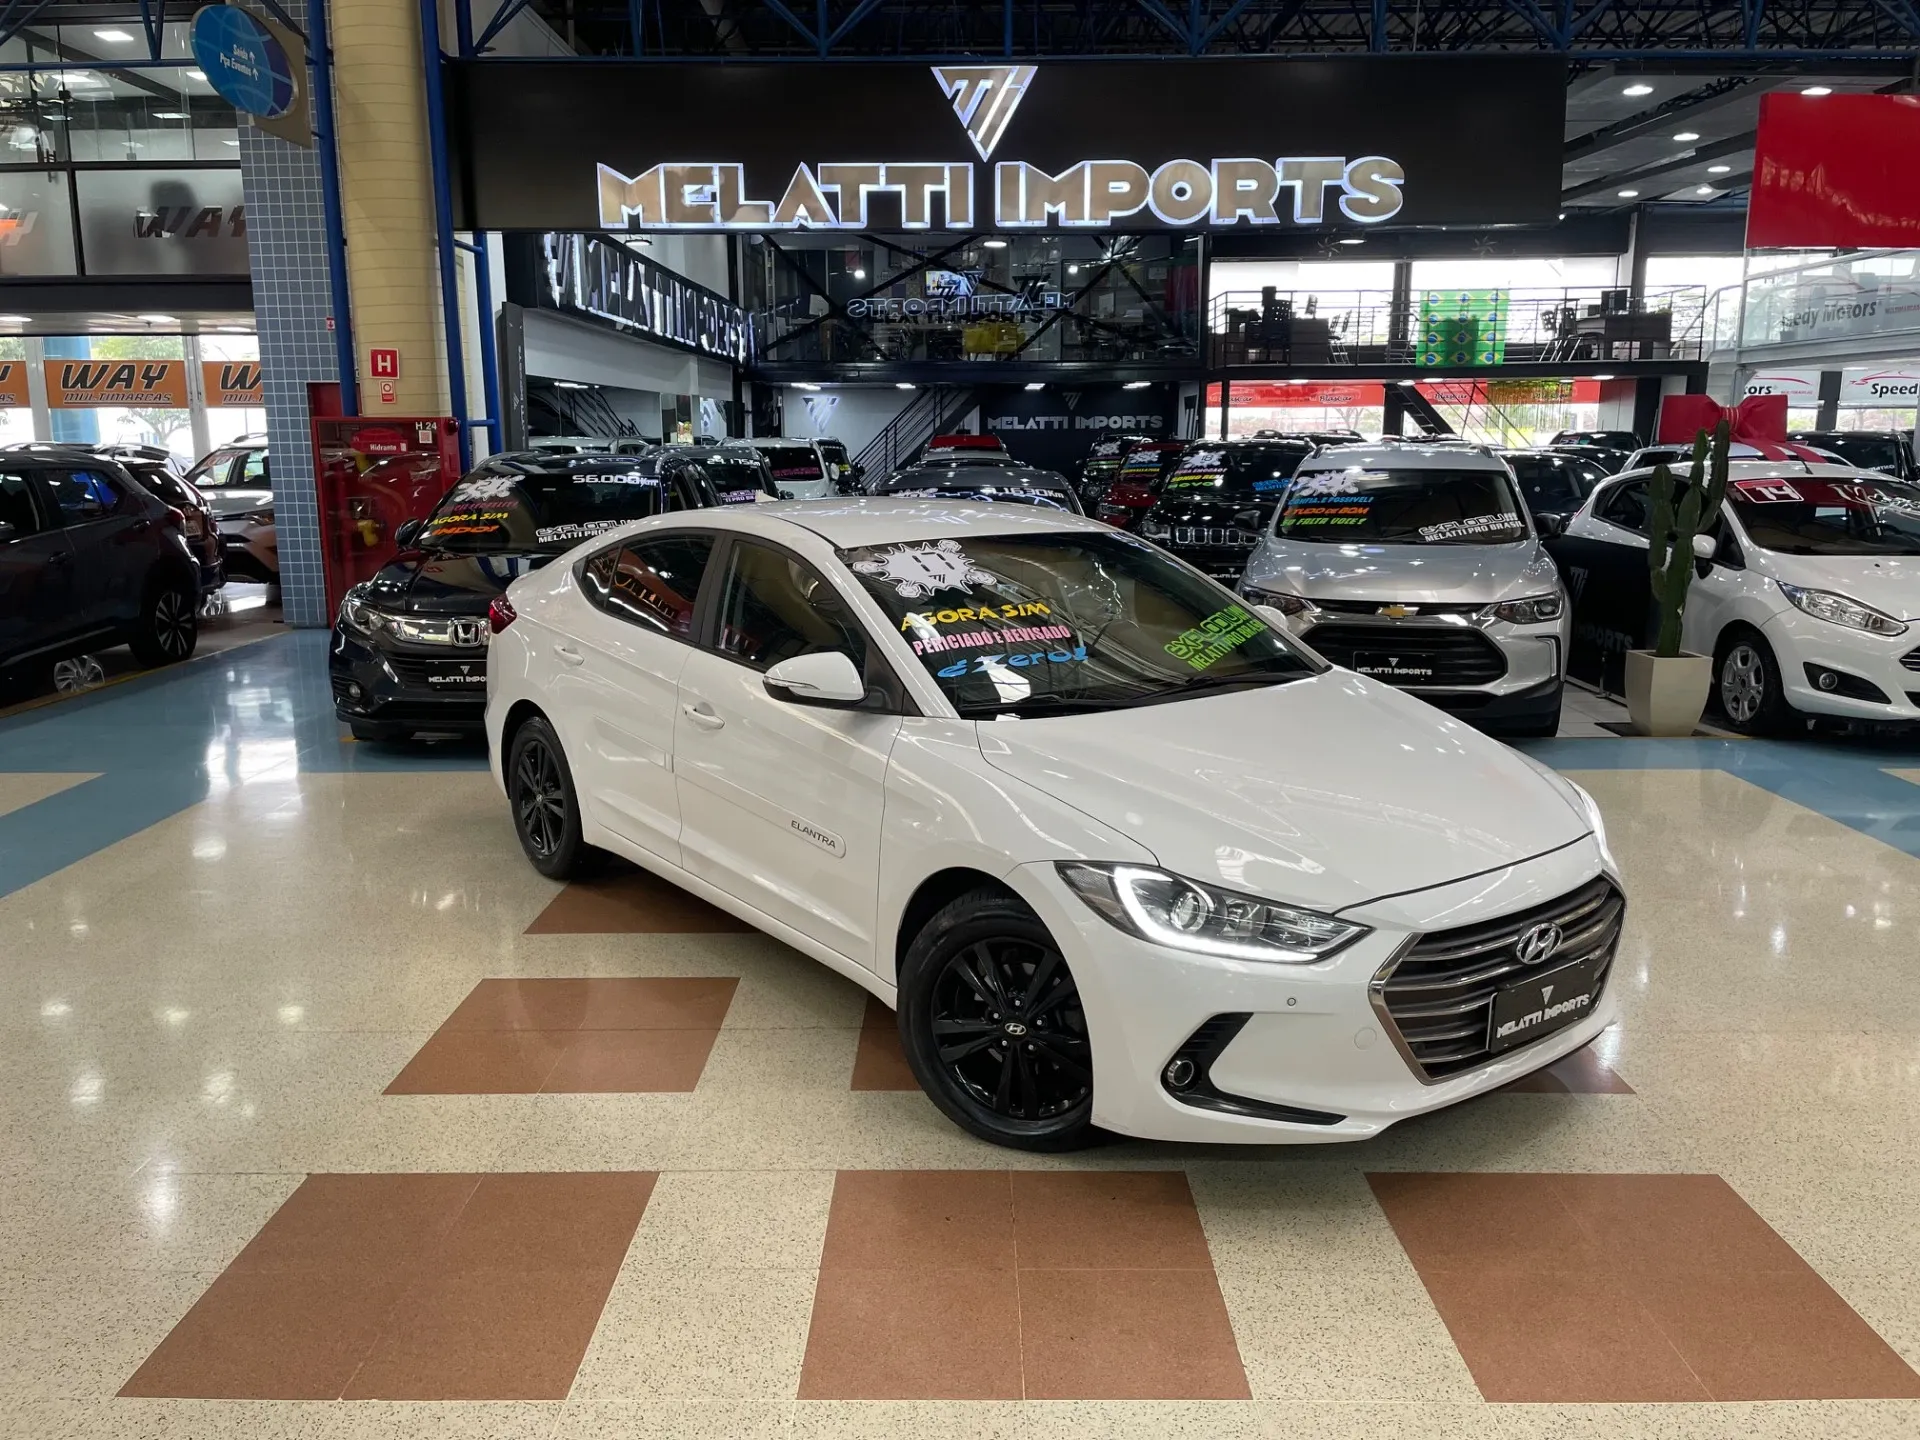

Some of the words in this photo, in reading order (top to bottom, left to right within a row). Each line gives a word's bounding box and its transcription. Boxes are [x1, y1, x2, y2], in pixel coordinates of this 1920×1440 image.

[597, 162, 974, 229] MELATTI
[995, 157, 1404, 226] IMPORTS
[377, 354, 391, 373] H
[61, 363, 169, 390] WAY
[64, 393, 172, 401] MULTIMARCAS
[1870, 383, 1920, 397] Speed
[987, 416, 1069, 430] MELATTI
[1075, 415, 1163, 429] IMPORTS
[538, 530, 582, 543] MELATTI
[1425, 529, 1467, 542] MELATTI
[1468, 525, 1488, 534] PRO
[1489, 520, 1525, 531] BRASIL
[901, 606, 999, 632] AGORA
[1000, 602, 1051, 618] SIM
[912, 631, 995, 656] PERICIADO
[1003, 625, 1072, 644] REVISADO
[1394, 667, 1432, 675] IMPORTS
[791, 819, 836, 849] ELANTRA
[1496, 1011, 1543, 1038] MELATTI
[1543, 994, 1590, 1021] IMPORTS
